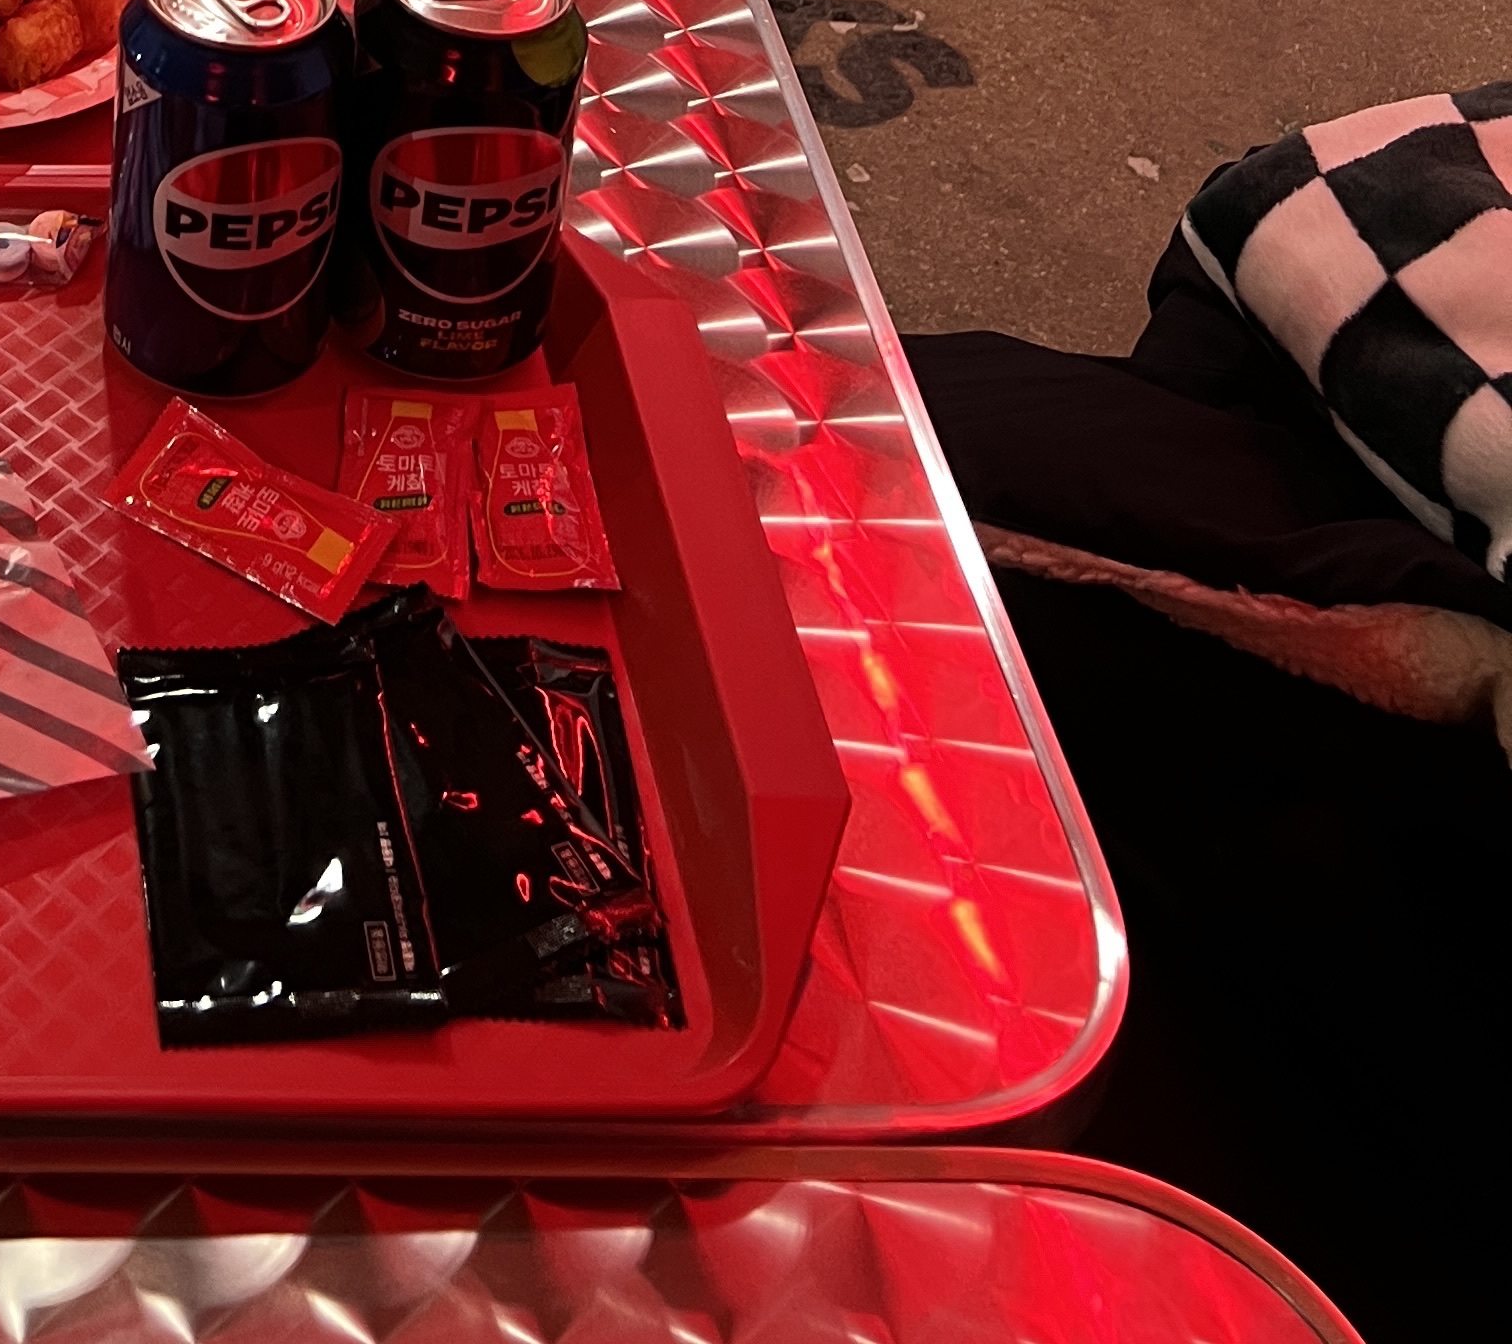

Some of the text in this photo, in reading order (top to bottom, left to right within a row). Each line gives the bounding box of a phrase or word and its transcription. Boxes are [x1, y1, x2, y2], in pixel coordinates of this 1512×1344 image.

[397, 308, 522, 330] ZERO SUGAR
[419, 337, 499, 351] FLAVOR
[437, 330, 485, 340] LIME
[377, 453, 436, 472] 토마토
[236, 485, 281, 532] 토마토
